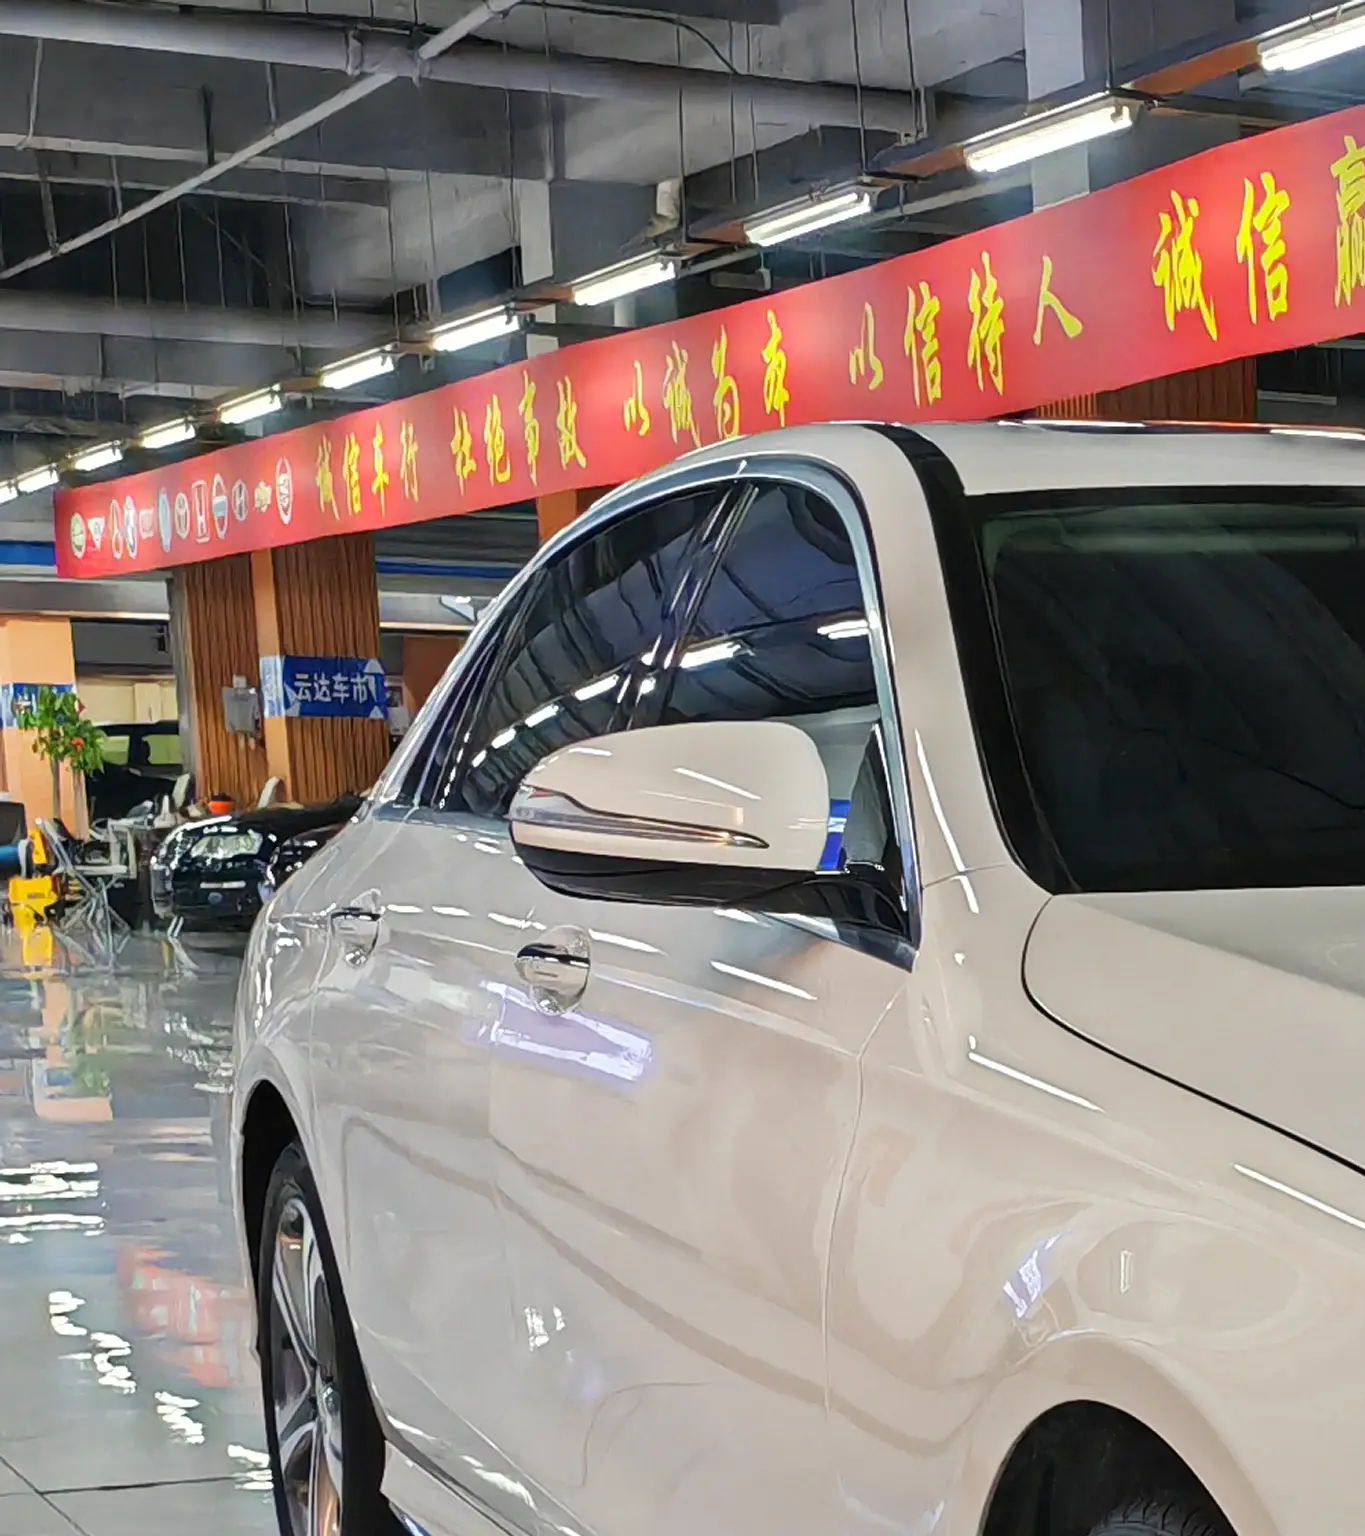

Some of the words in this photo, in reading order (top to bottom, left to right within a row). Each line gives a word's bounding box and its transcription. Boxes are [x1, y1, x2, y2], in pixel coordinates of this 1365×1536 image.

[315, 418, 420, 522] 诚信车行
[848, 250, 1085, 408] 以信待人
[293, 671, 370, 705] 云达车市
